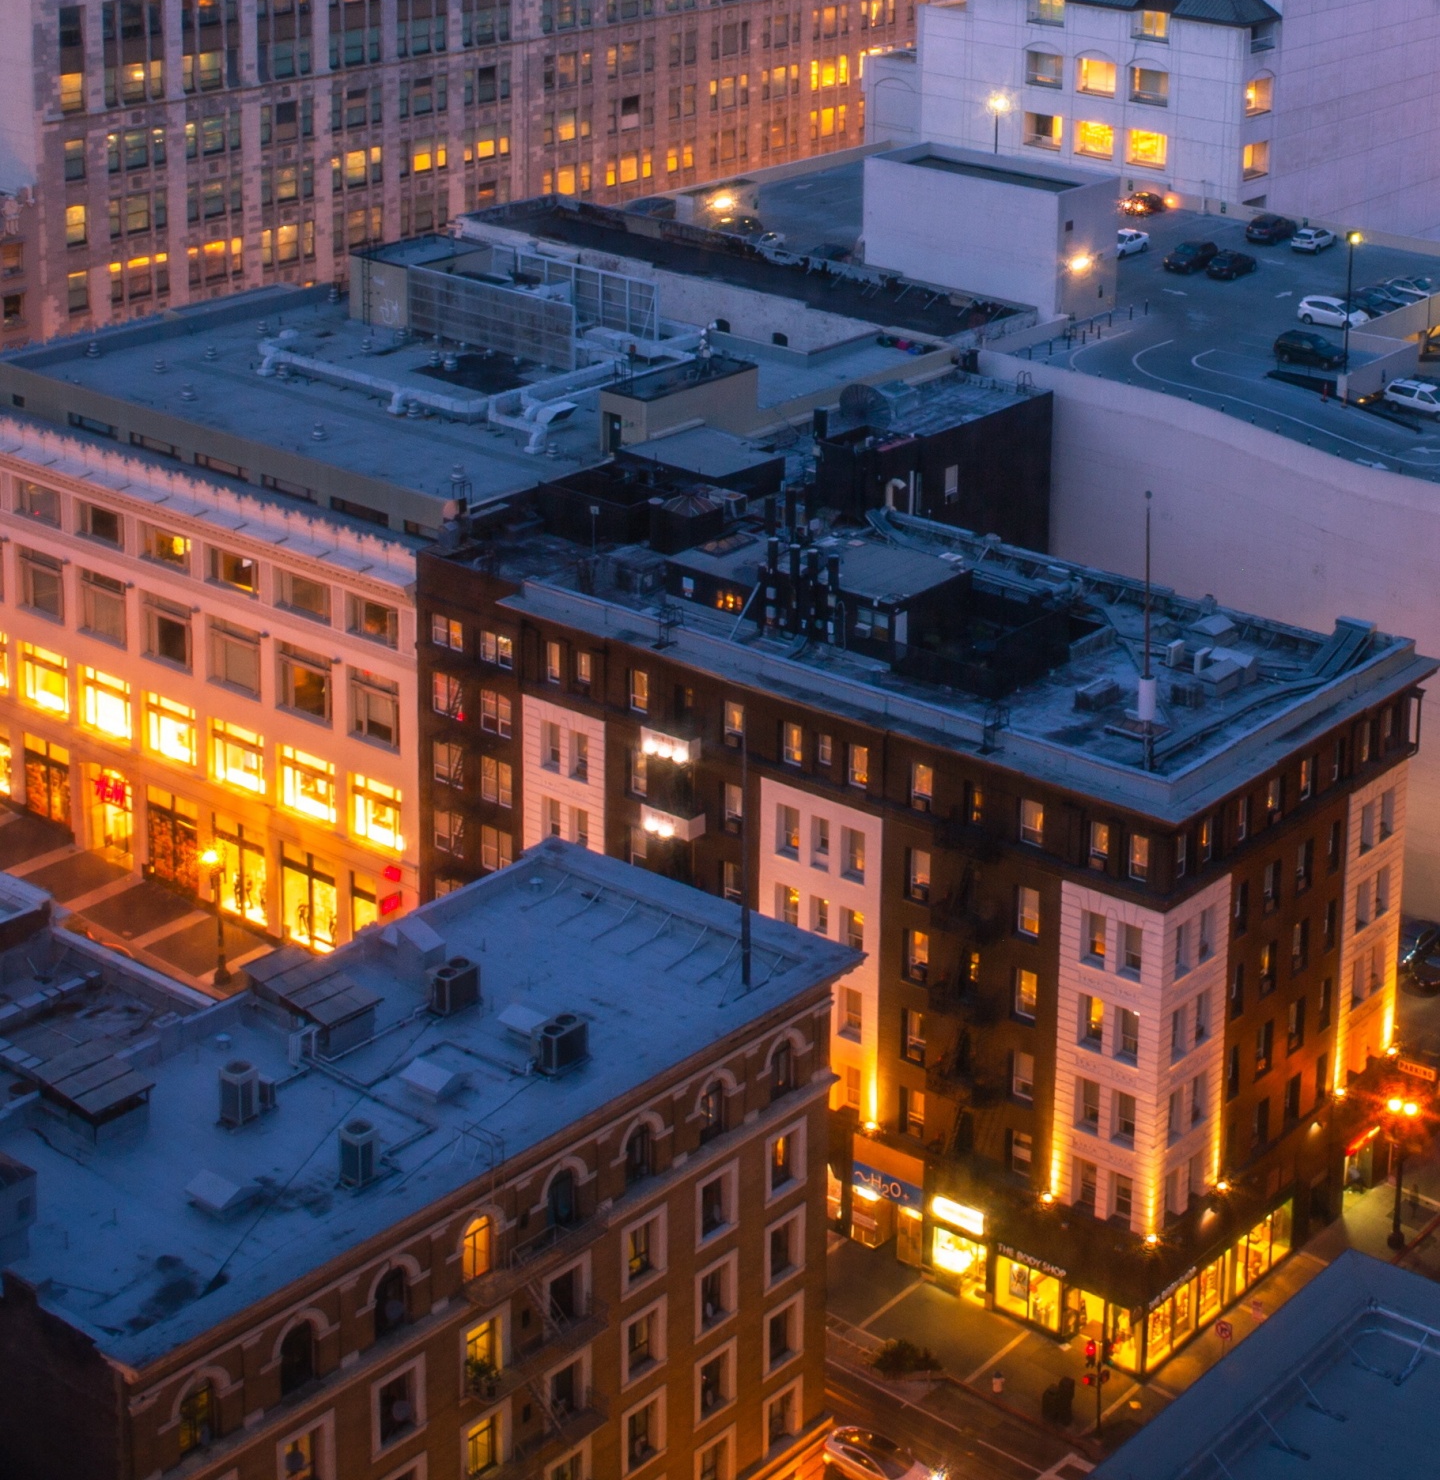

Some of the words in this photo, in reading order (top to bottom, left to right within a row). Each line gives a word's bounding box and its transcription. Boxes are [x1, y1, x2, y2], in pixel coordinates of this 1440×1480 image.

[1400, 1061, 1433, 1079] PARKING
[997, 1242, 1014, 1258] THE
[1016, 1250, 1041, 1267] BODY
[1042, 1261, 1067, 1278] SHOP
